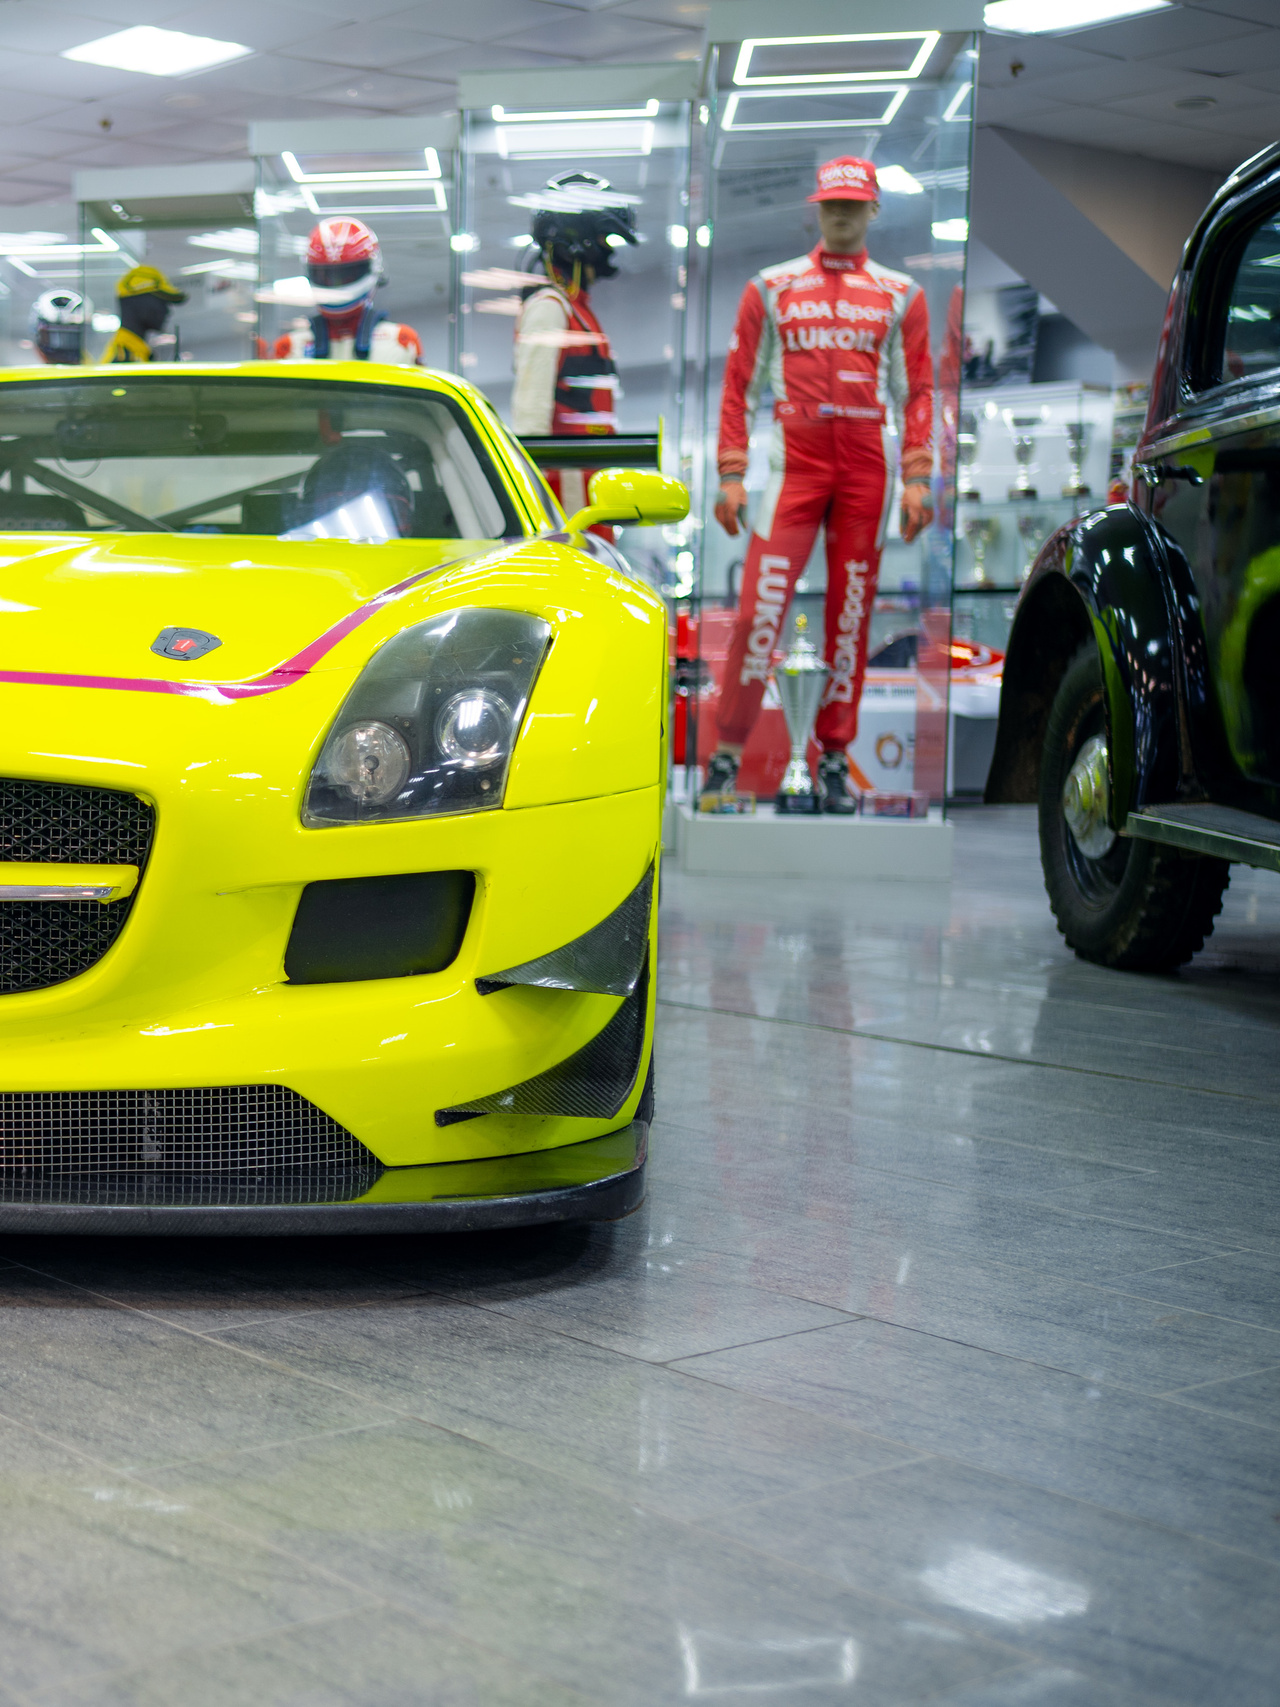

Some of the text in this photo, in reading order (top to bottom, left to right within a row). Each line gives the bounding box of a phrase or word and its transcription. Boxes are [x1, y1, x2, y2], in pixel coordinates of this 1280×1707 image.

[776, 299, 895, 327] LADA Sport
[786, 325, 877, 354] LUKOIL
